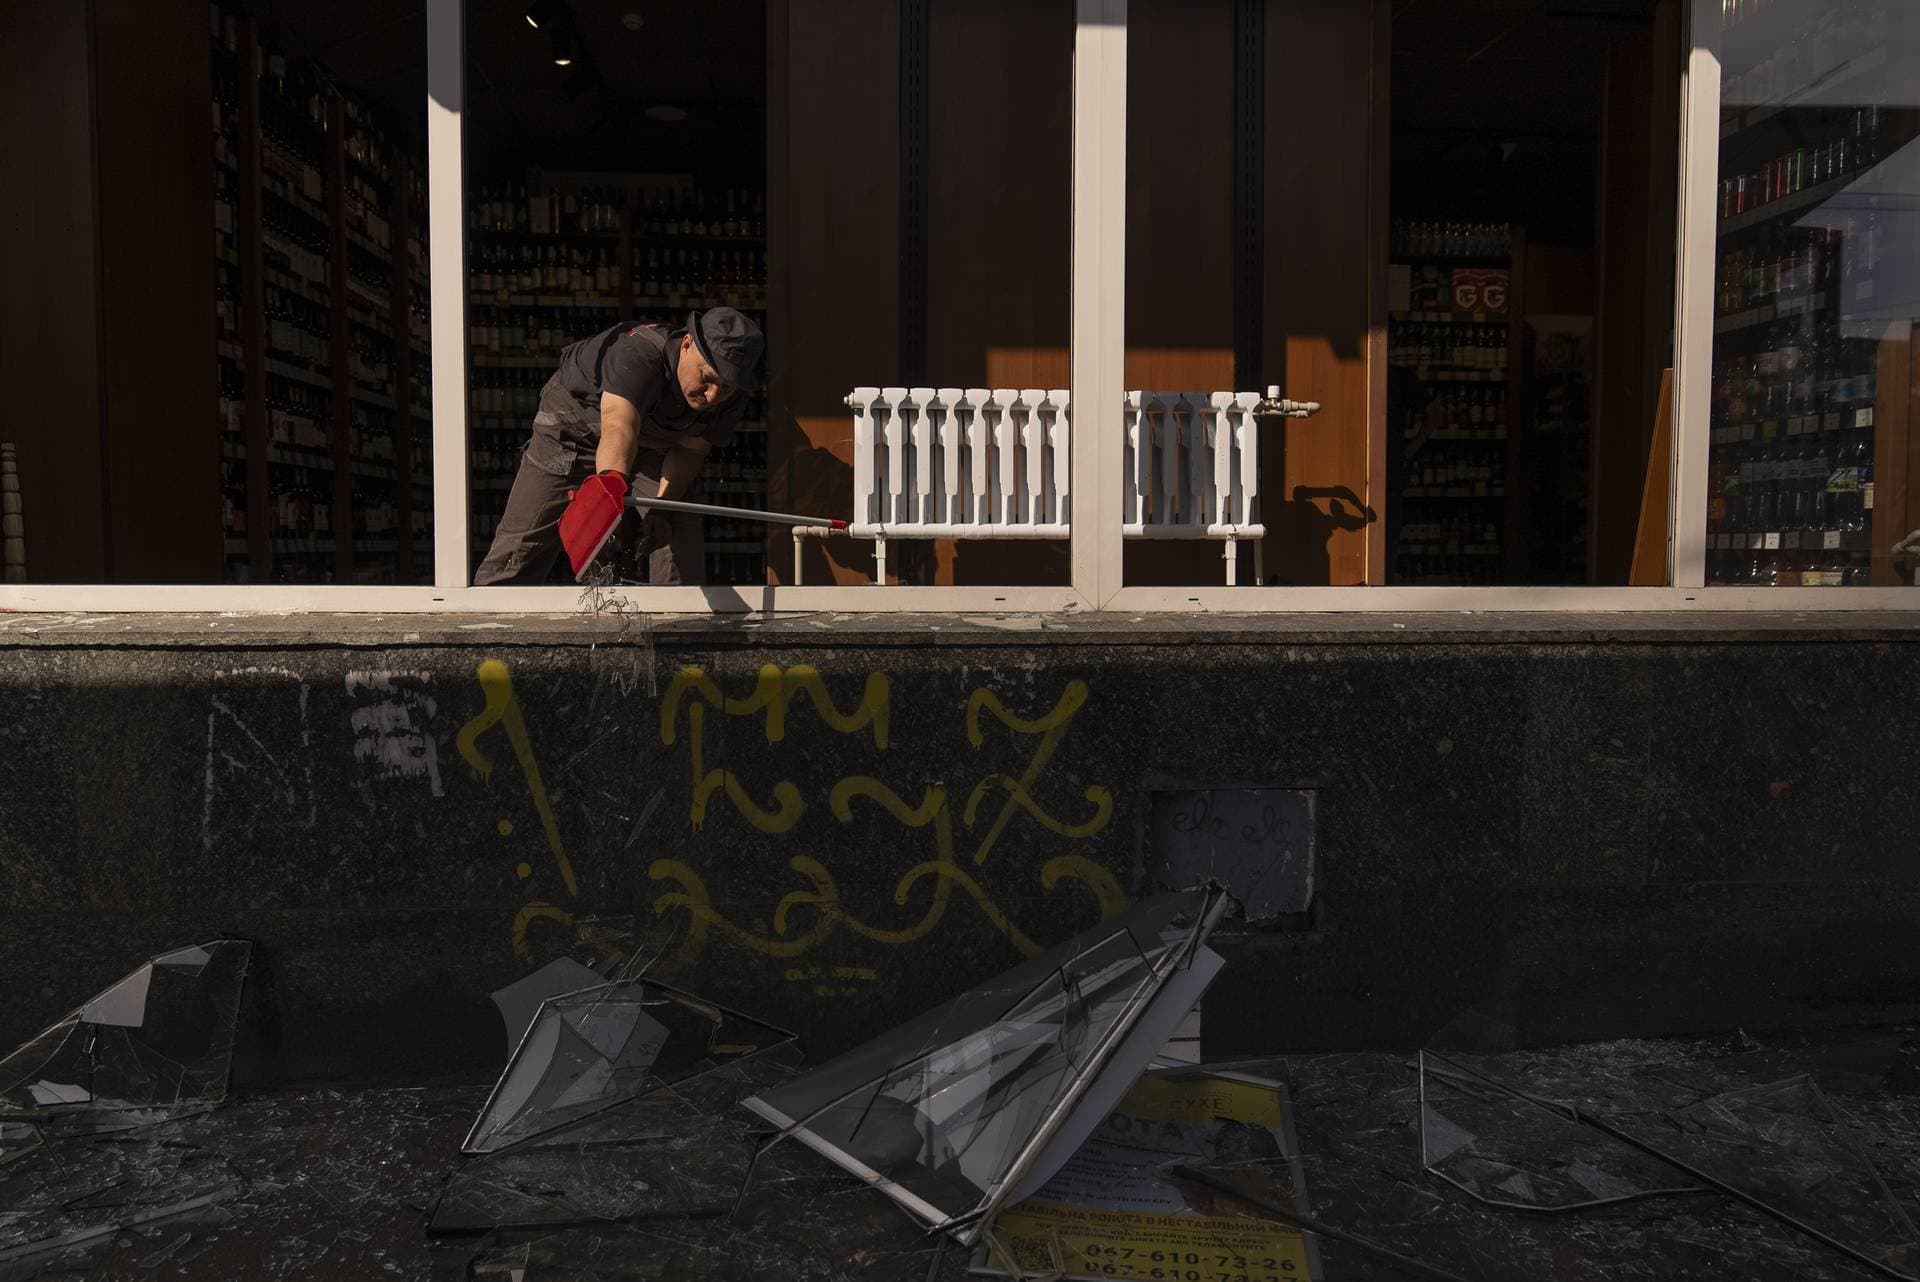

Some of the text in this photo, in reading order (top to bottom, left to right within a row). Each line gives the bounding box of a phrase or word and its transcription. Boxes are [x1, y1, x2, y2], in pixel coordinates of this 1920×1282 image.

[1103, 1111, 1185, 1138] ОТА
[1157, 1216, 1266, 1233] НЕСТАБІЛЬНИЙ
[1086, 1244, 1295, 1272] 067-610-73-26
